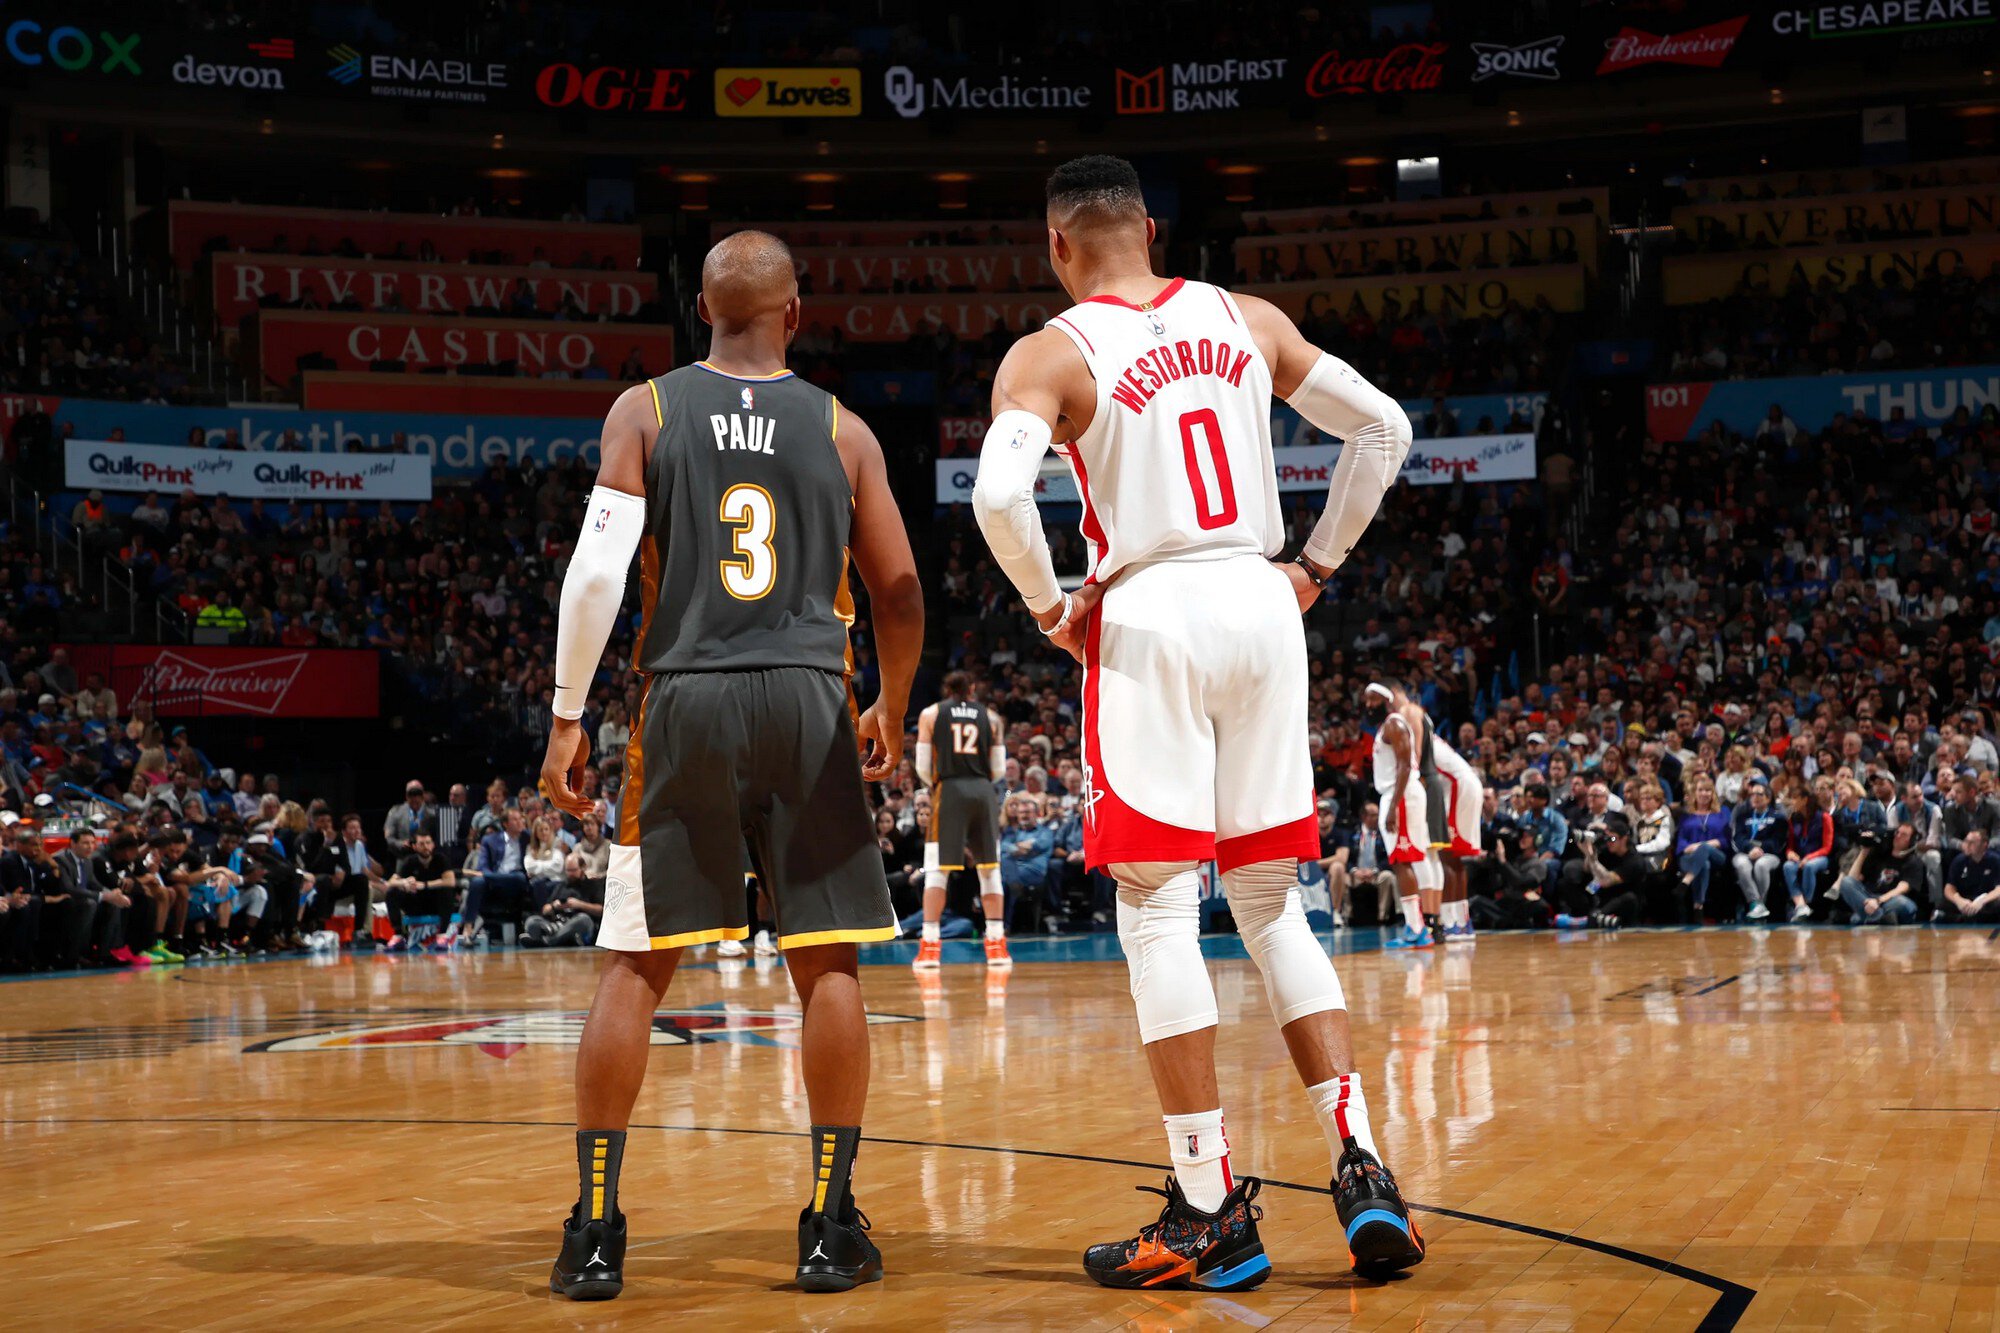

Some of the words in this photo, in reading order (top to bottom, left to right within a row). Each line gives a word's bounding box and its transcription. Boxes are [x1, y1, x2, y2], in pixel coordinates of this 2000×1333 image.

[1772, 0, 1991, 34] CHESAPEAKE
[5, 19, 142, 76] COX
[1477, 47, 1558, 74] SONIC
[1604, 33, 1737, 63] Budweiser
[172, 54, 285, 90] devon
[370, 54, 508, 88] ENABLE
[371, 86, 432, 98] MIDSTREAM
[434, 91, 486, 102] PARTNERS
[931, 75, 1091, 109] Medicine
[1172, 88, 1241, 112] BANK
[1742, 248, 1964, 291] CASINO
[1304, 280, 1510, 317] CASINO
[845, 303, 1050, 334] CASINO
[348, 325, 595, 370] CASINO
[1112, 339, 1252, 415] WESTBROOK
[1650, 386, 1689, 407] 101
[709, 413, 776, 455] PAUL
[943, 420, 986, 439] 120
[89, 453, 193, 485] QuikPrint
[254, 463, 364, 491] QuikPrint
[1178, 408, 1238, 530] 0
[1402, 452, 1479, 474] uikPrint
[719, 482, 777, 601] 3
[146, 664, 290, 692] Budweiser
[950, 722, 978, 754] 12
